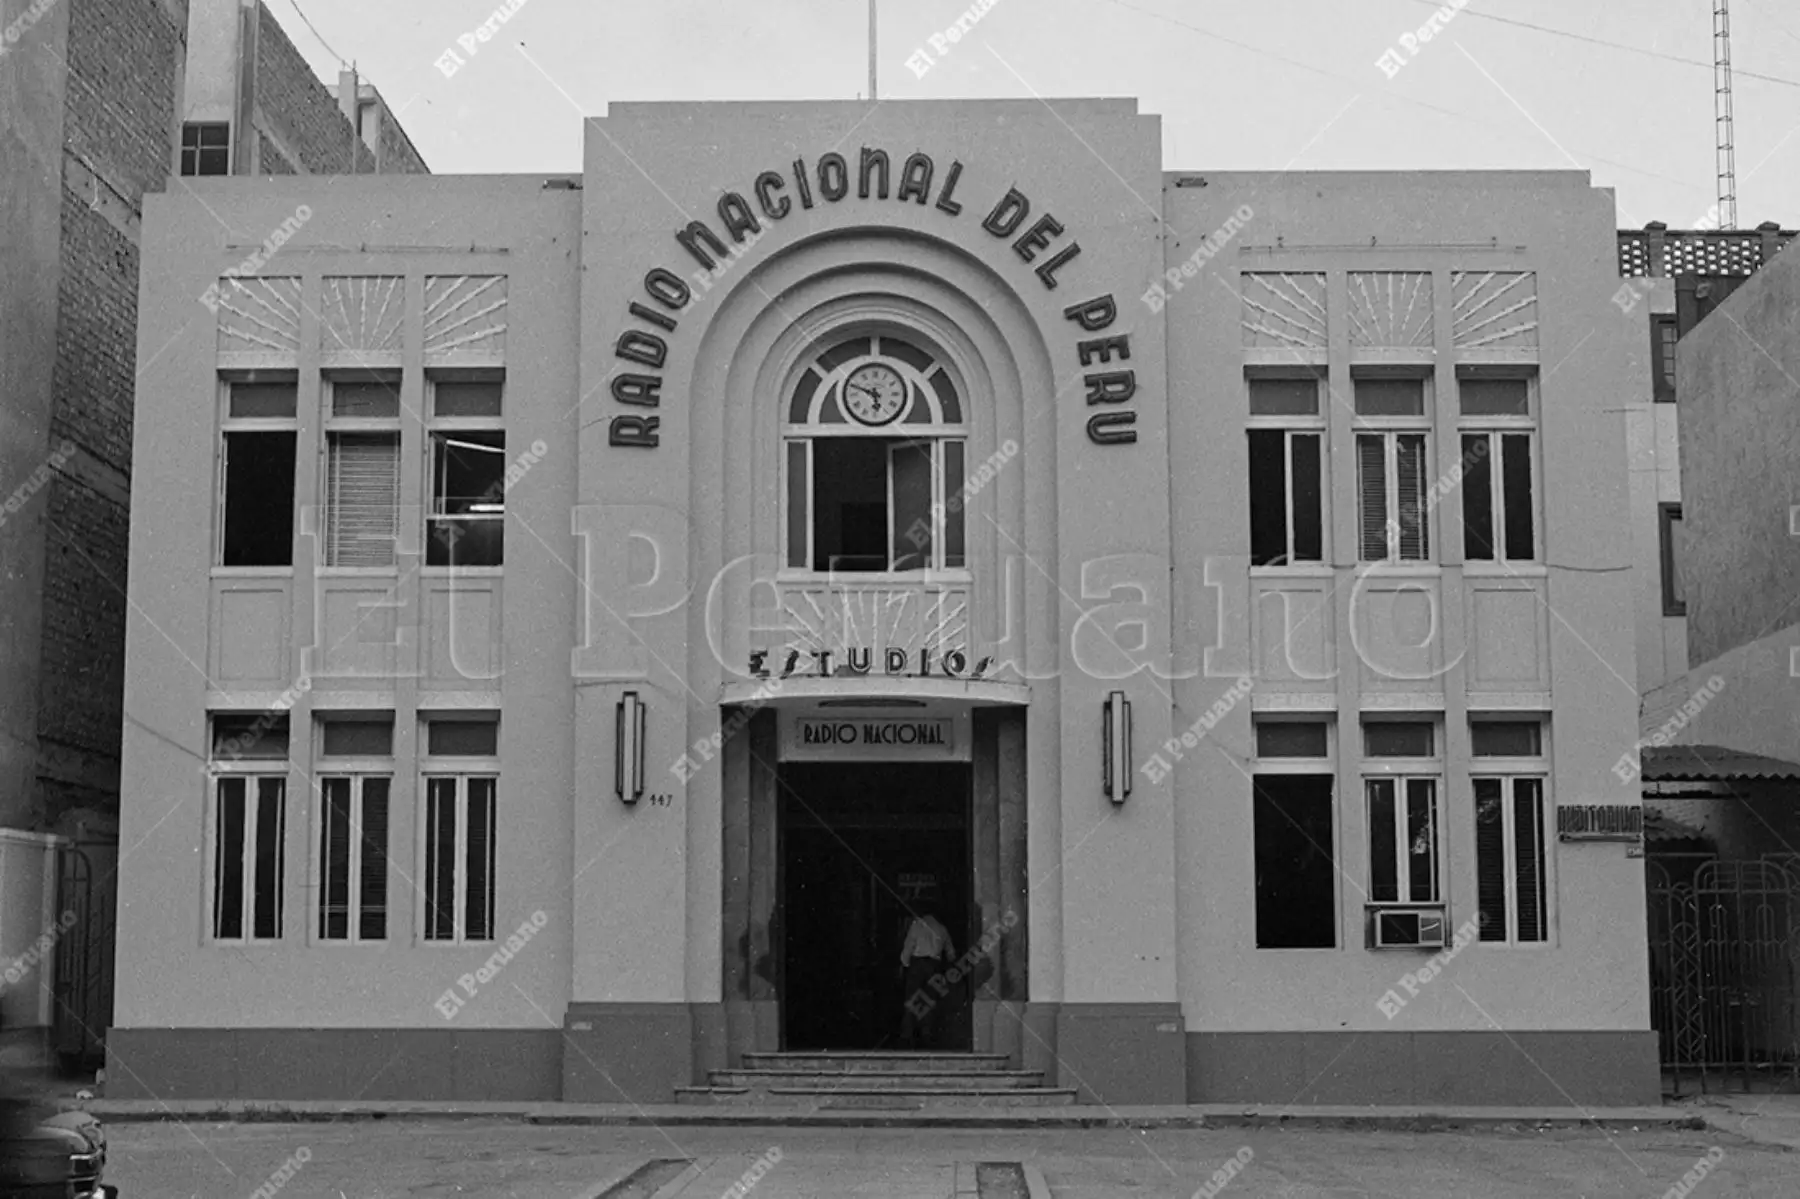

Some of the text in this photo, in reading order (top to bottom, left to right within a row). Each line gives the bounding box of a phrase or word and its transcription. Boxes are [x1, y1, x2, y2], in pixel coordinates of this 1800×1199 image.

[609, 146, 1137, 448] RADIO NACIONAL DEL PERU
[747, 646, 995, 680] ESTUDIOS
[803, 722, 945, 745] RADIO NACIONAL
